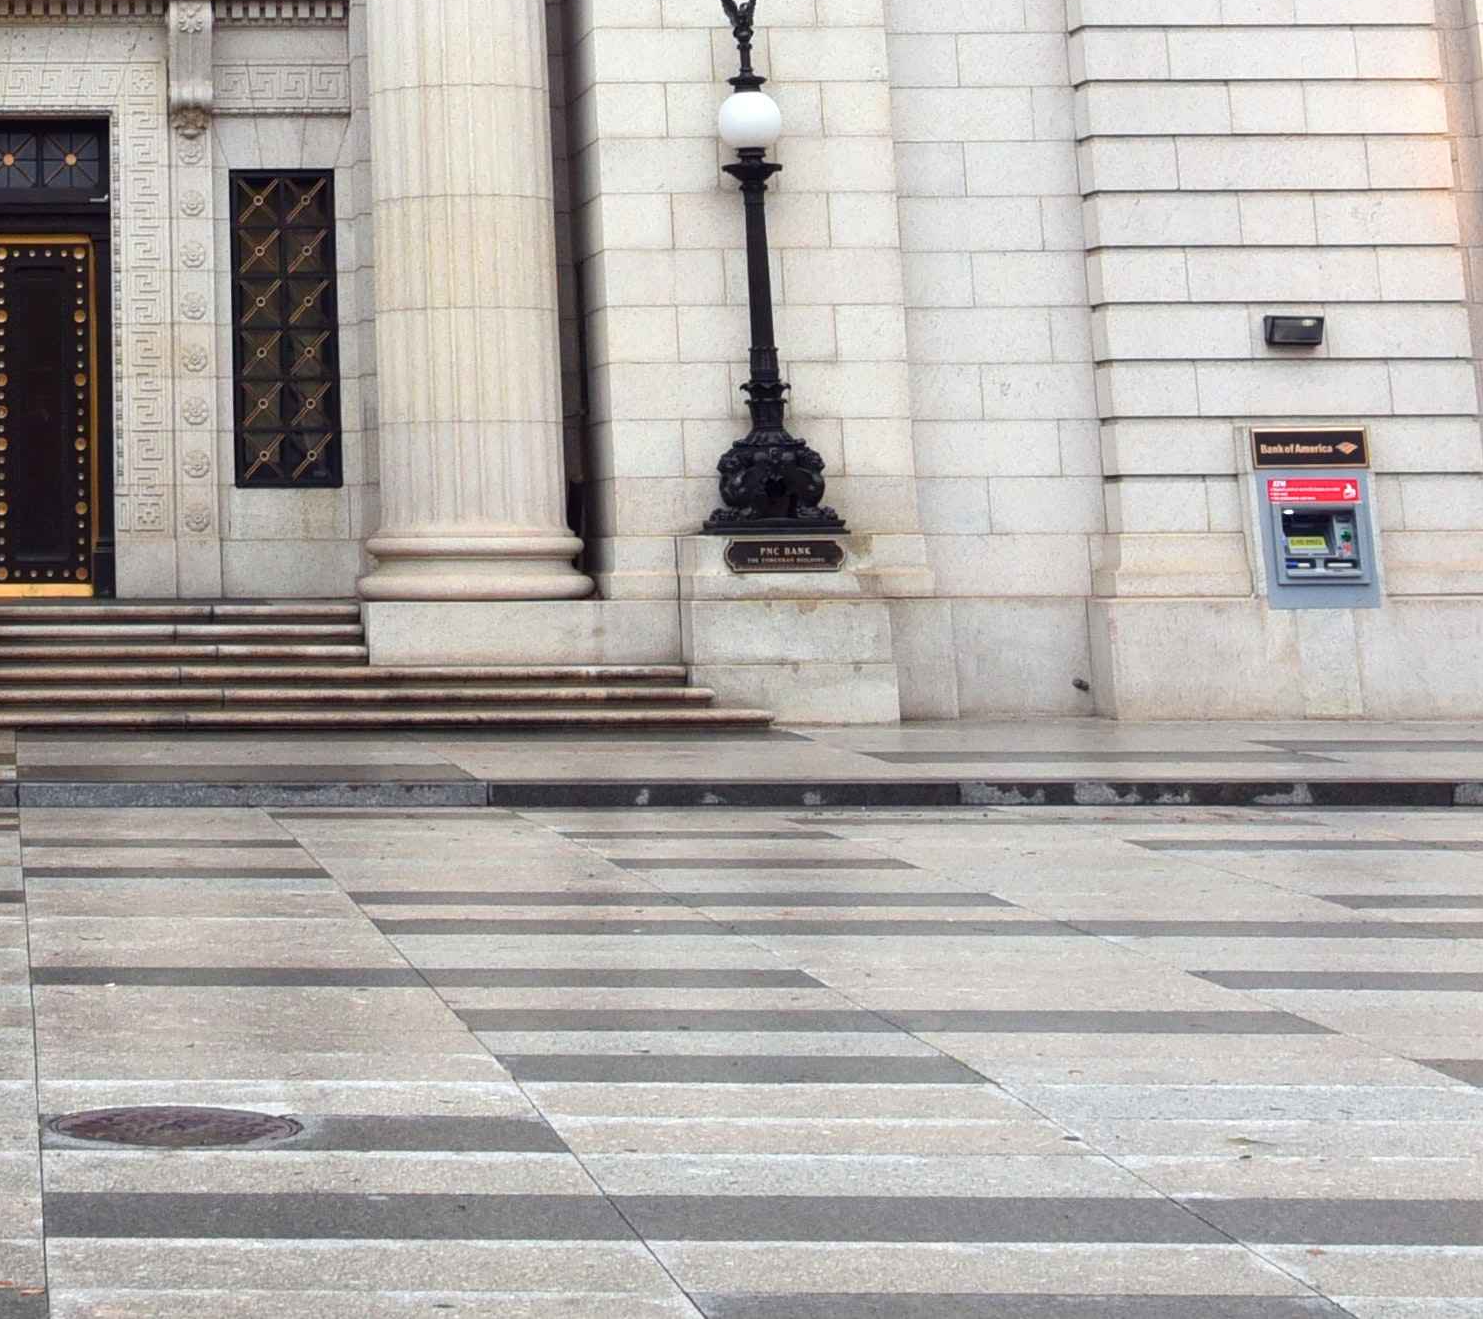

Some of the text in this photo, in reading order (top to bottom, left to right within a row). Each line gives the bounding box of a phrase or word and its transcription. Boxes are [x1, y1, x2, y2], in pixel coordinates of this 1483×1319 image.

[1260, 443, 1333, 454] Bank of America
[760, 547, 811, 555] PNC BANK
